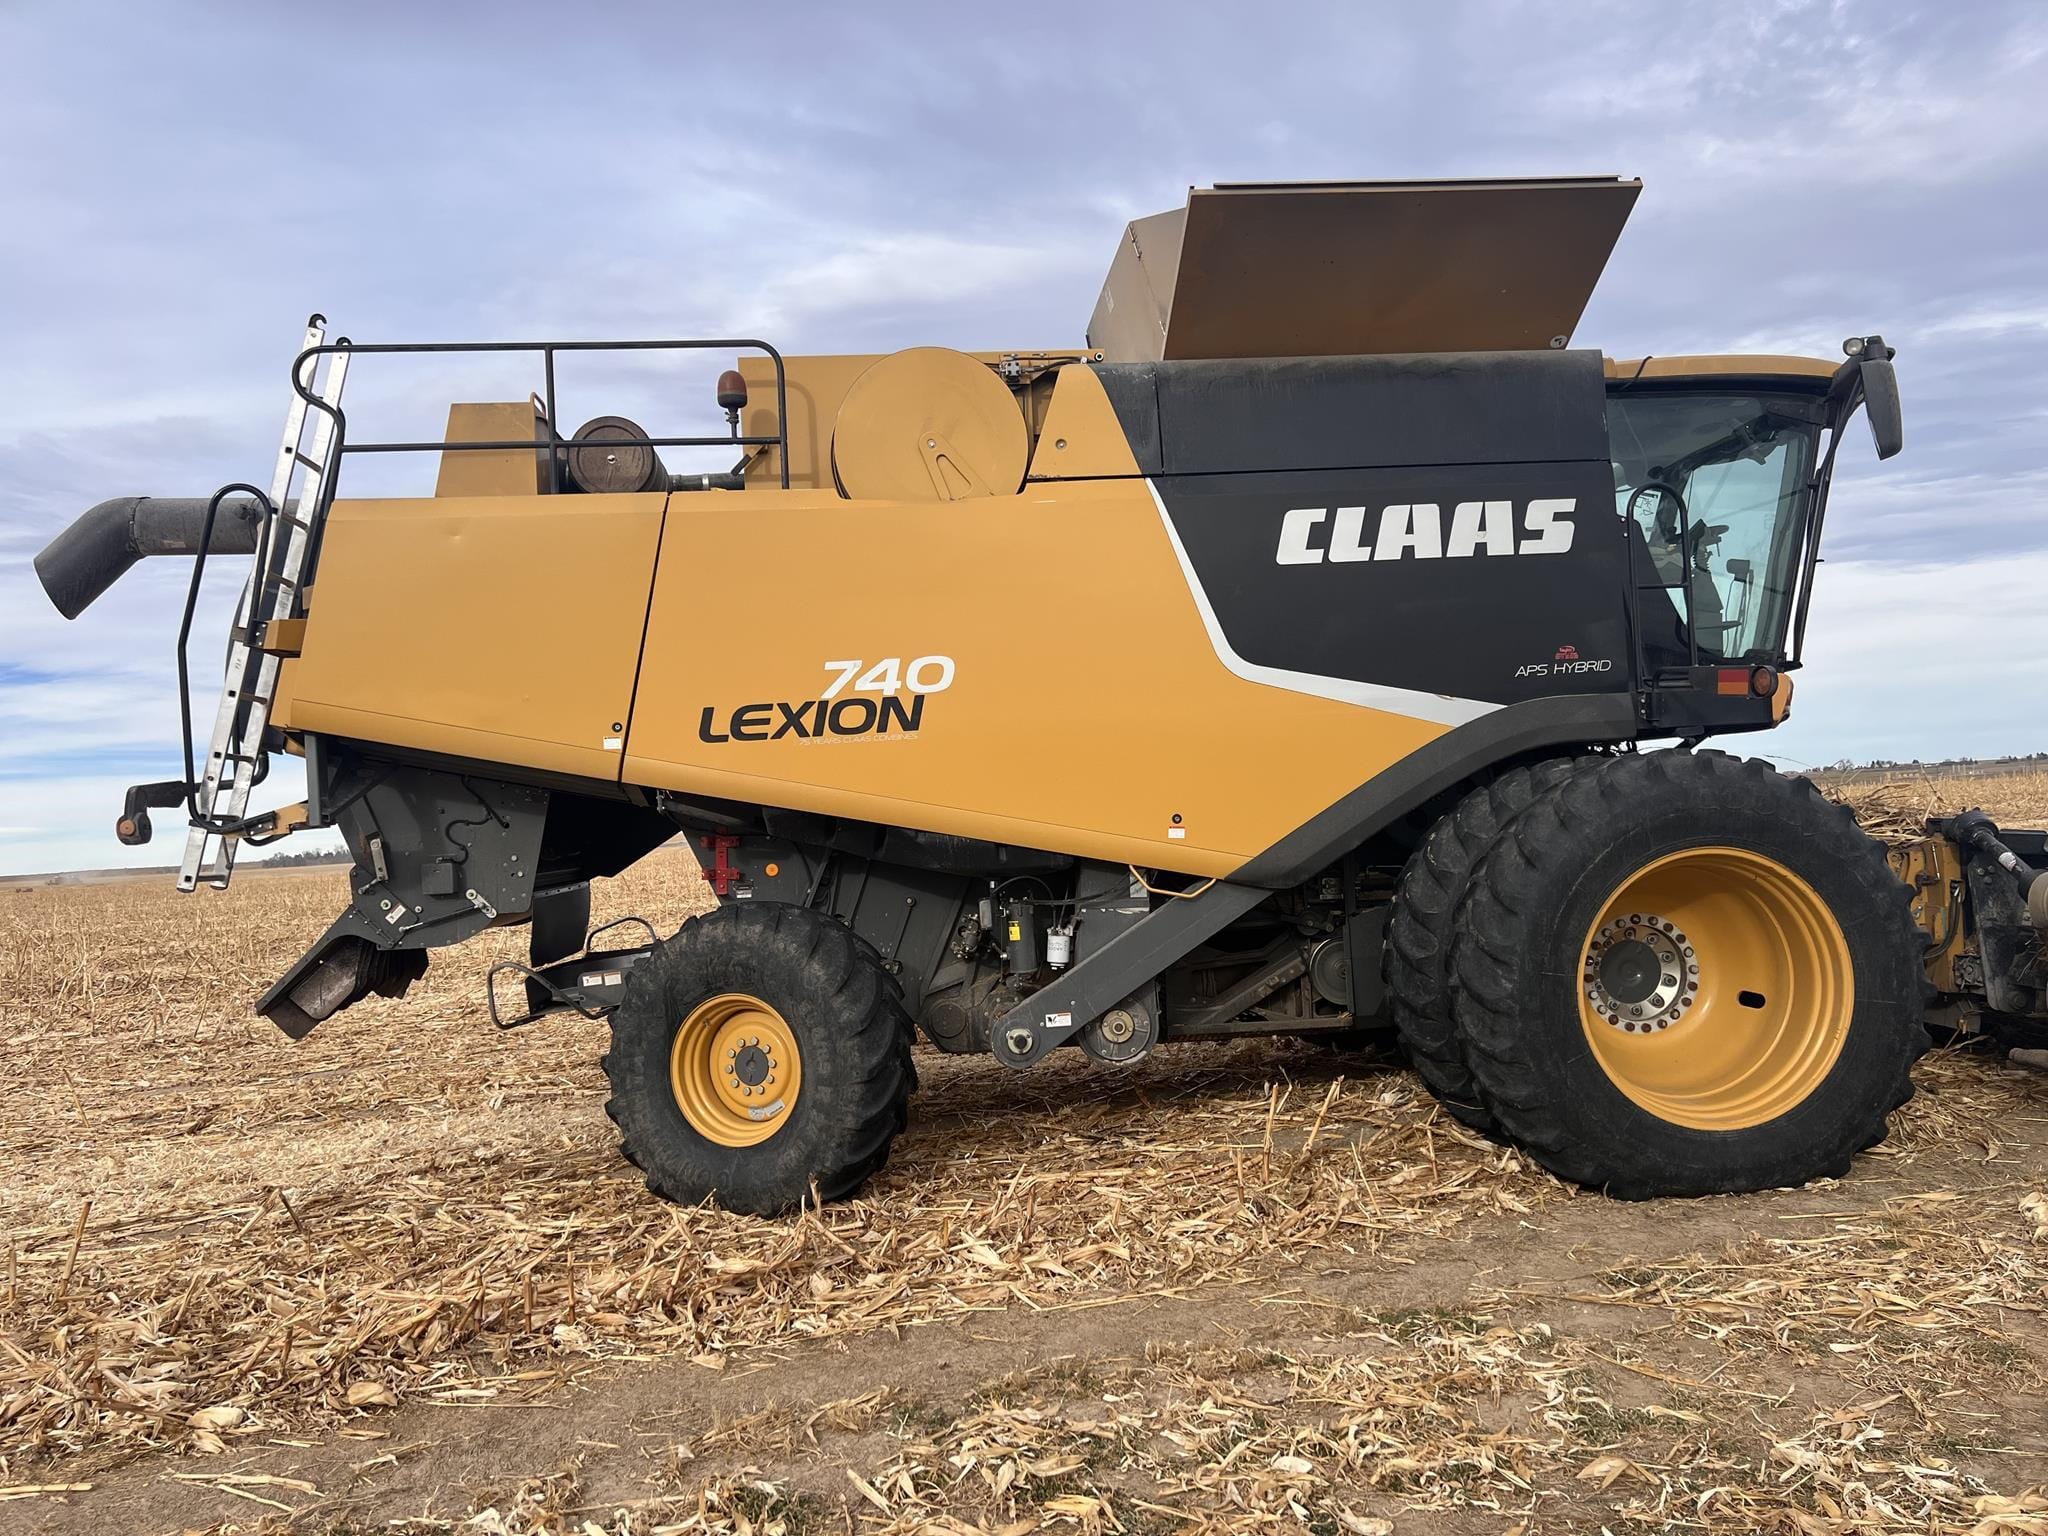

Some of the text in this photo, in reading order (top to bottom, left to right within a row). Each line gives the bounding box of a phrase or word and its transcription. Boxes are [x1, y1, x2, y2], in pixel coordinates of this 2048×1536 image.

[1276, 498, 1577, 565] CLAAS
[820, 655, 956, 699] 740
[1514, 660, 1612, 677] APS HYBRID
[698, 694, 925, 743] LEXION
